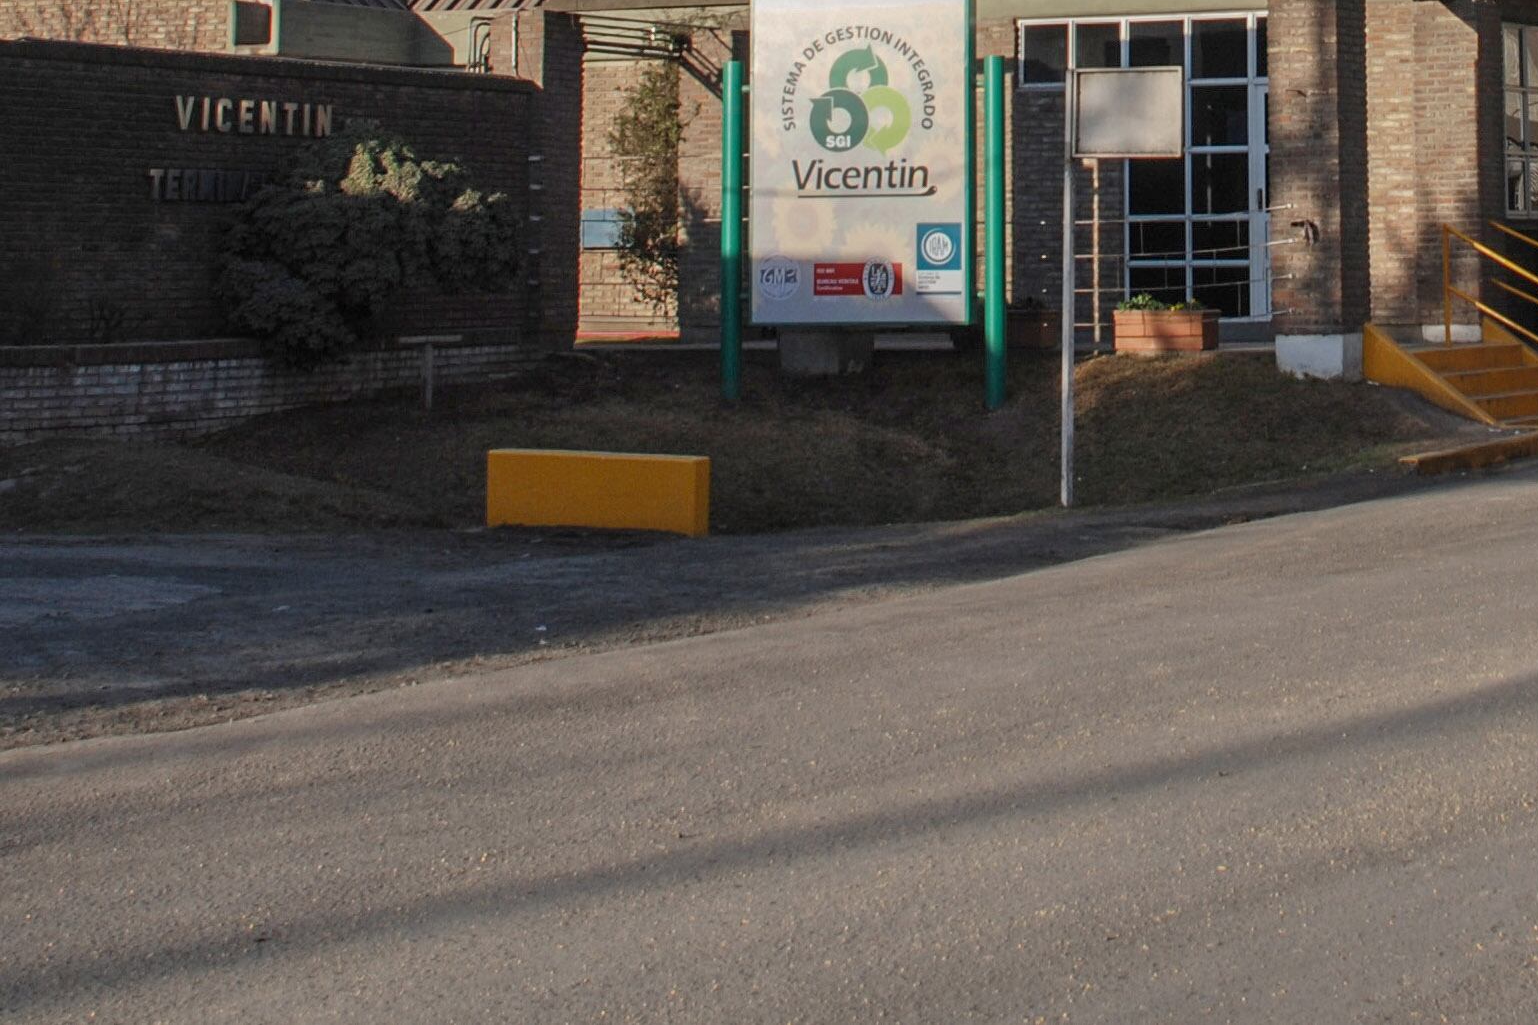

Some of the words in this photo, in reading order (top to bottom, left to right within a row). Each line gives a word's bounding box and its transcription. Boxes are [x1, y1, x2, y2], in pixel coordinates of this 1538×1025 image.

[781, 61, 807, 132] SISTEMA
[803, 39, 825, 61] DE
[824, 25, 894, 46] GESTION
[893, 38, 936, 130] INTEGRADO
[175, 95, 333, 137] VICENTIN
[825, 135, 851, 148] SGI
[792, 158, 930, 190] Vicentin
